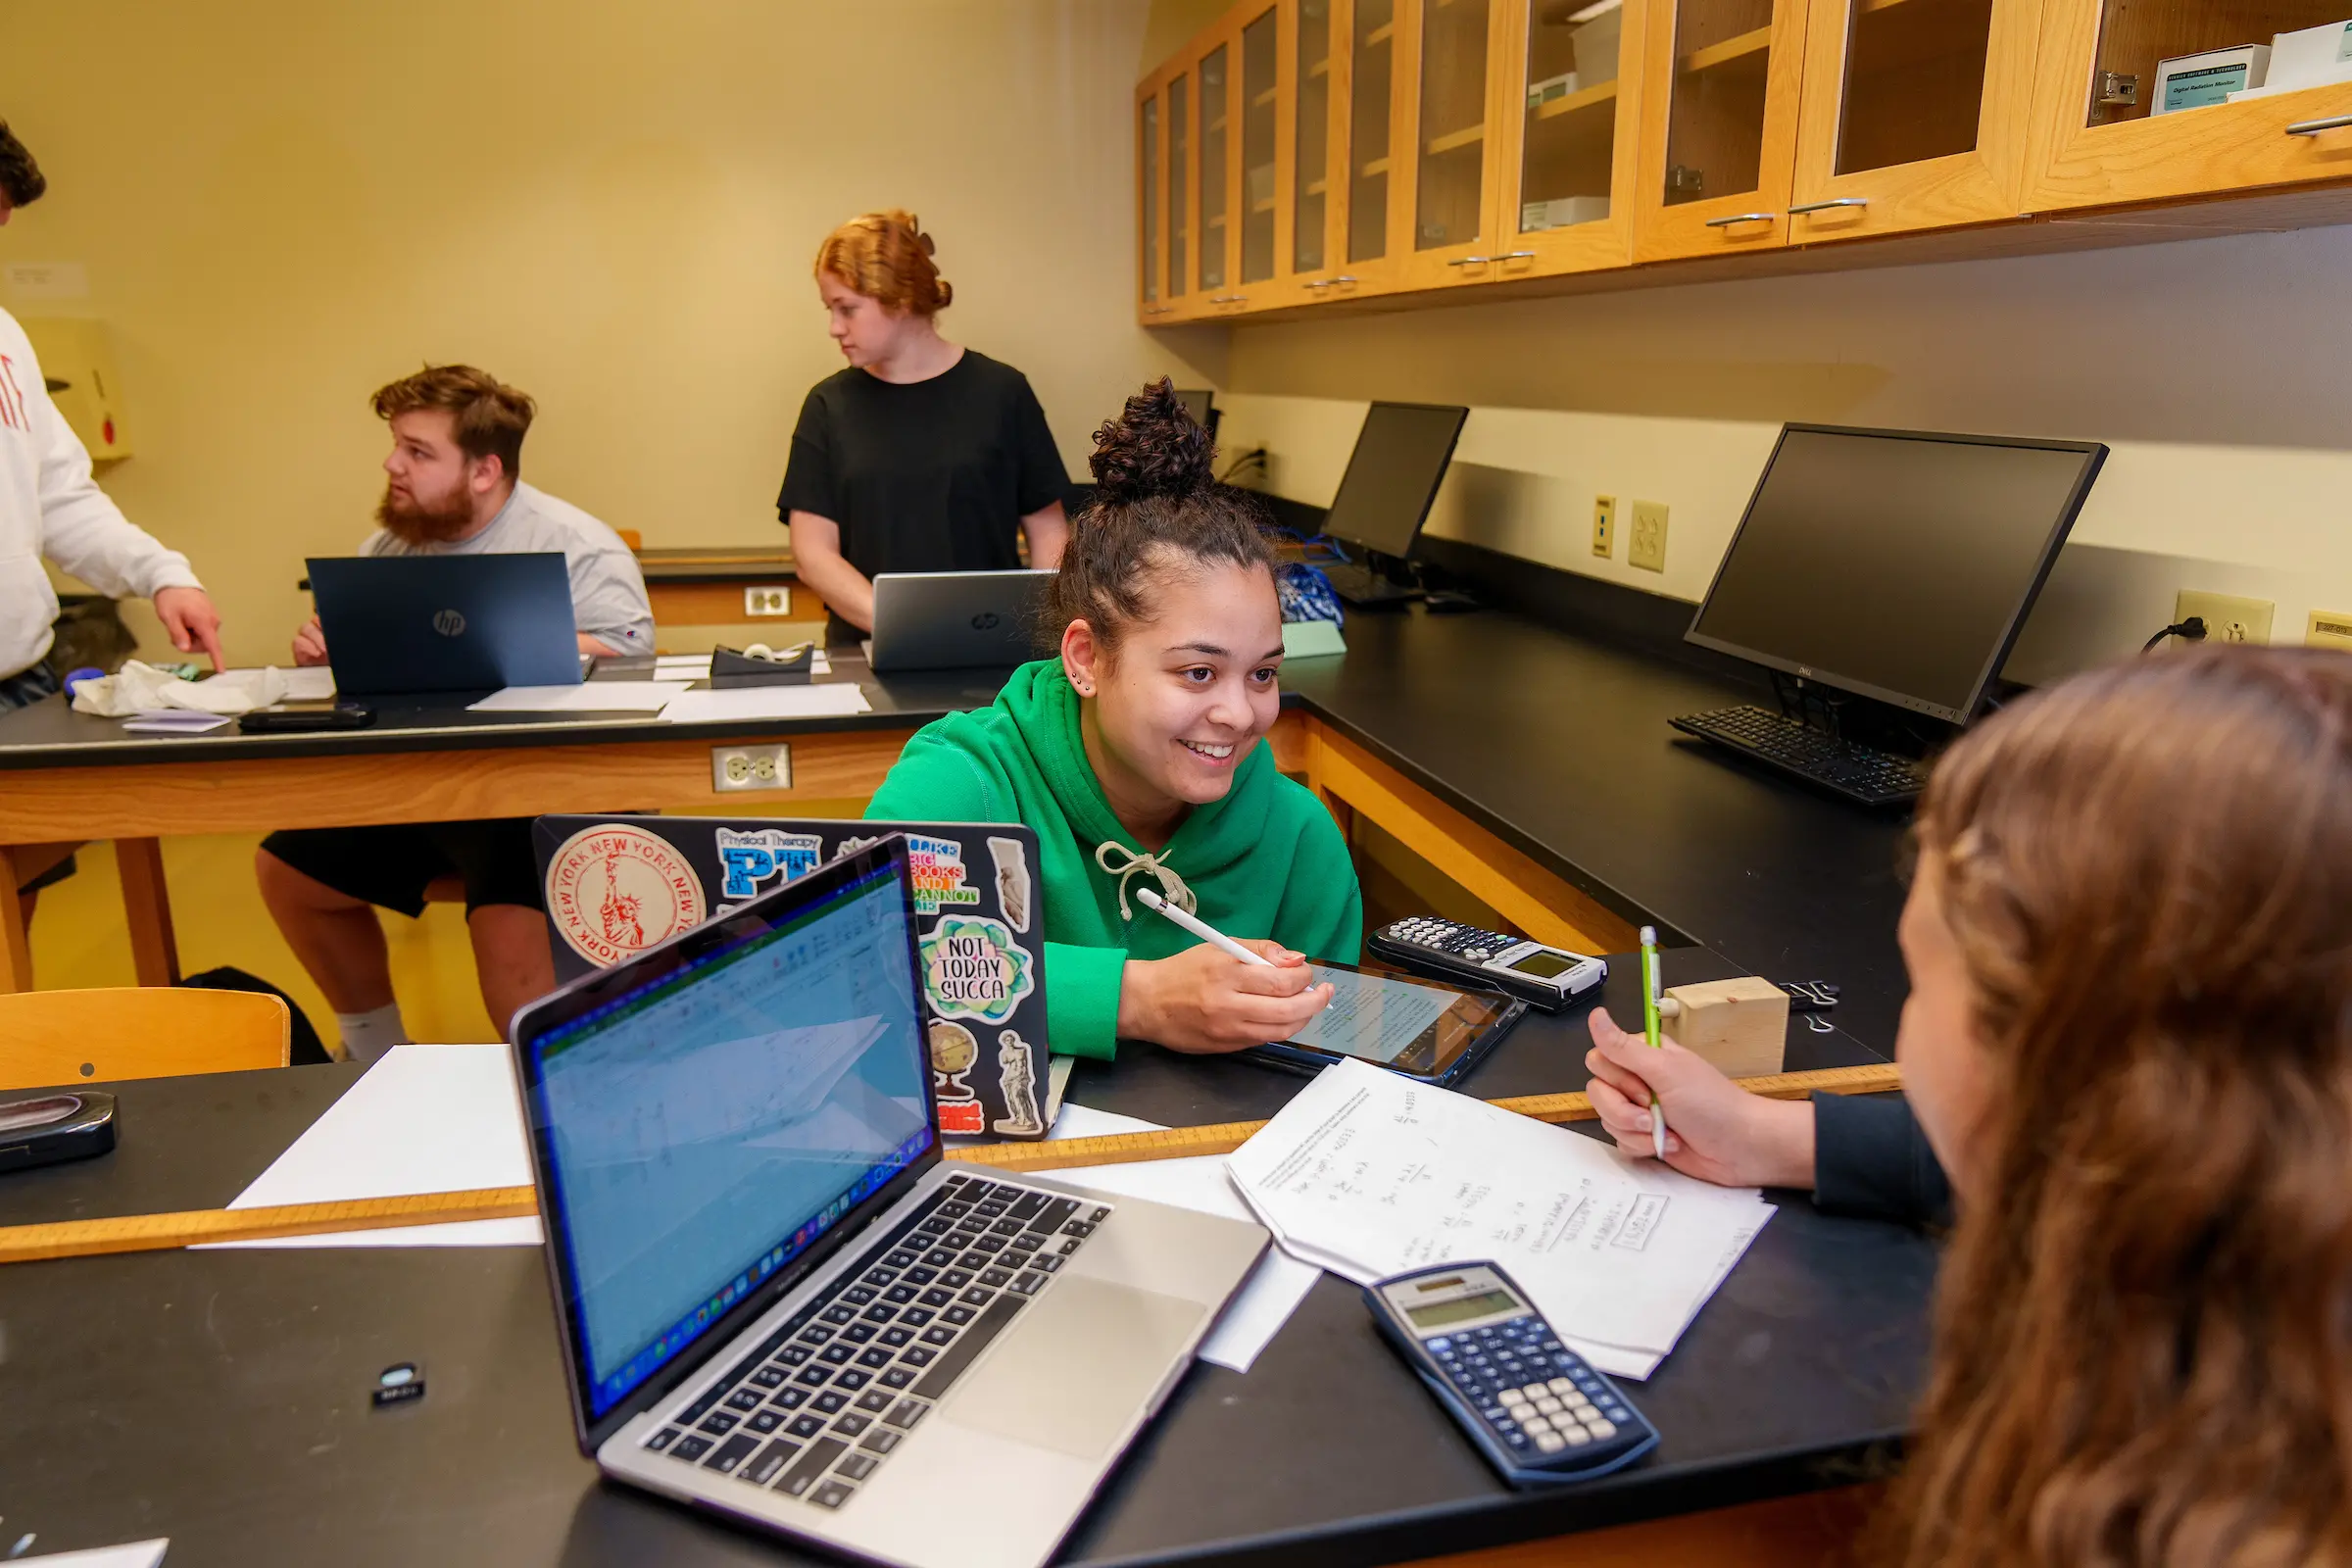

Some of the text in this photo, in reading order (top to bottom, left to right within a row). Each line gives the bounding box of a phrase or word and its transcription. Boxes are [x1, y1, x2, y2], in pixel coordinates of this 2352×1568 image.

[2190, 82, 2214, 91] Radiation
[589, 838, 628, 855] NEW
[720, 832, 819, 849] Physical Therapy
[633, 841, 677, 875] YORK
[910, 854, 936, 866] BIG
[561, 851, 589, 887] YORK
[722, 848, 817, 895] PT
[672, 877, 695, 911] NEW
[561, 892, 580, 927] NEW
[949, 937, 985, 957] NOT
[942, 957, 1002, 979] TODAY
[941, 980, 1004, 1000] SUCCA
